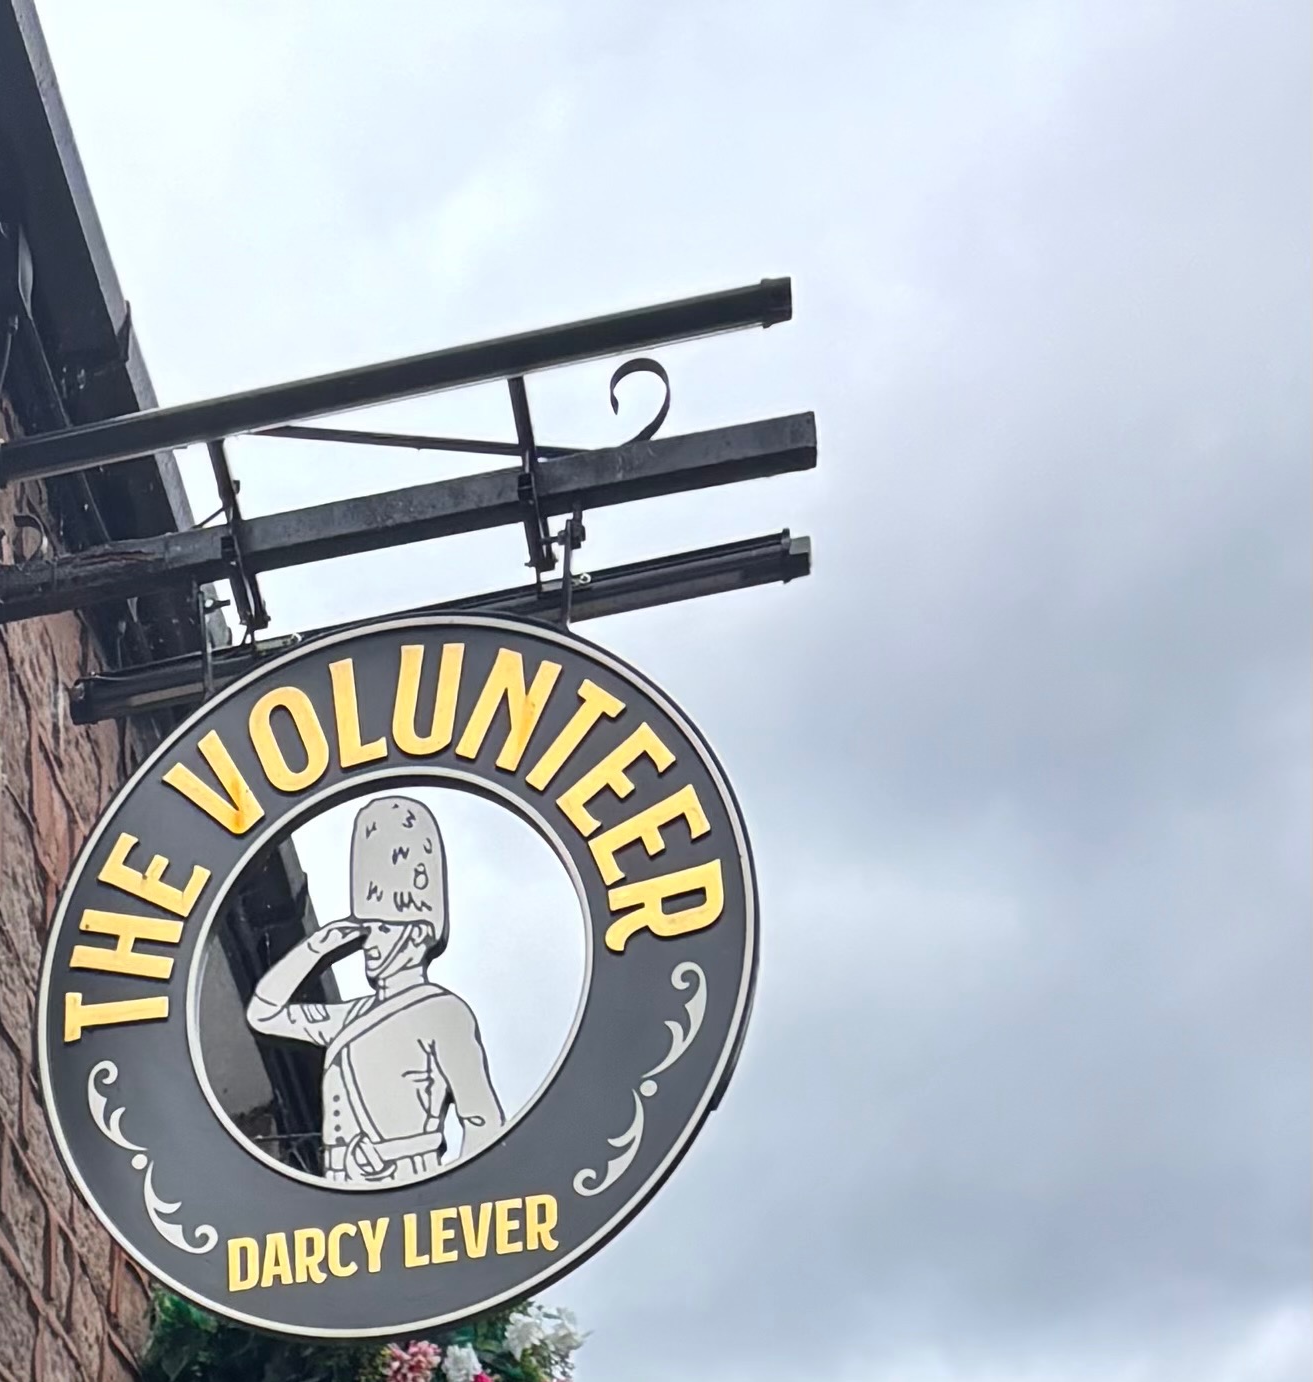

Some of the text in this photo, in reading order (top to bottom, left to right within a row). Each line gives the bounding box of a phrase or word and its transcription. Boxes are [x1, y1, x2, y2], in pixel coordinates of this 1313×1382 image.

[64, 642, 725, 1043] THE VOLUNTEER
[226, 1194, 559, 1293] DARCY LEVER
